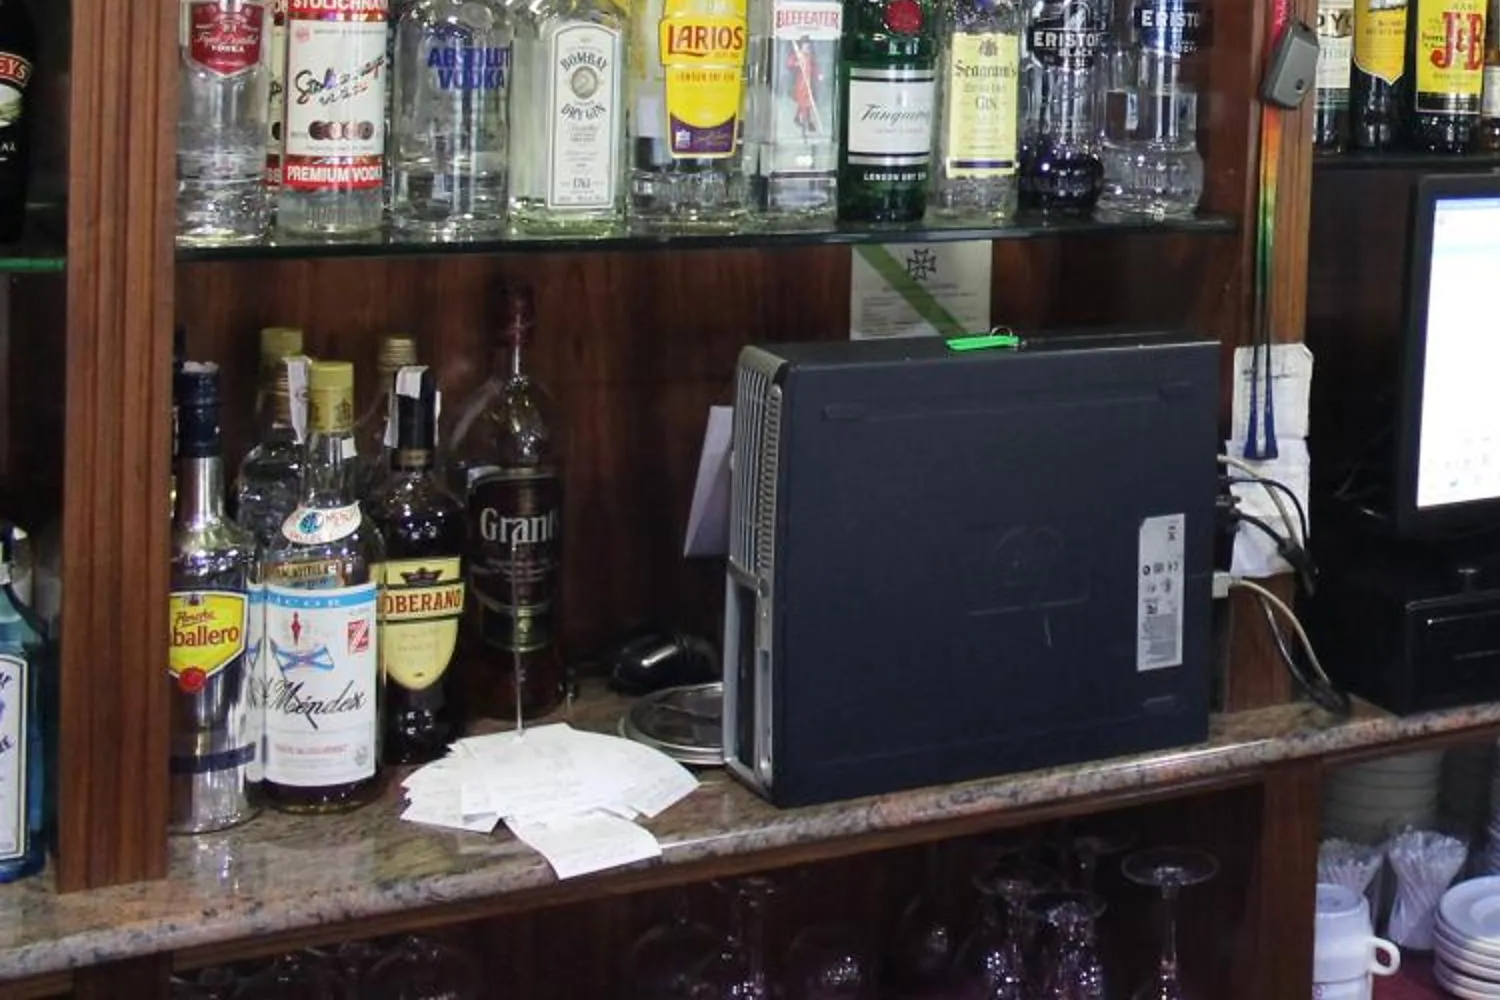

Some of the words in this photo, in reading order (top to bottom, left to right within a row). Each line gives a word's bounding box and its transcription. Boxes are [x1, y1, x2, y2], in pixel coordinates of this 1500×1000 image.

[775, 10, 840, 29] BEEFEATER
[667, 23, 744, 58] LARIOS
[427, 47, 512, 68] ABSOLUT
[560, 51, 608, 74] BOMBAY
[438, 68, 507, 90] VODKA
[287, 165, 348, 183] PREMIUM
[863, 171, 900, 182] LONDON
[381, 590, 462, 618] OBERANO
